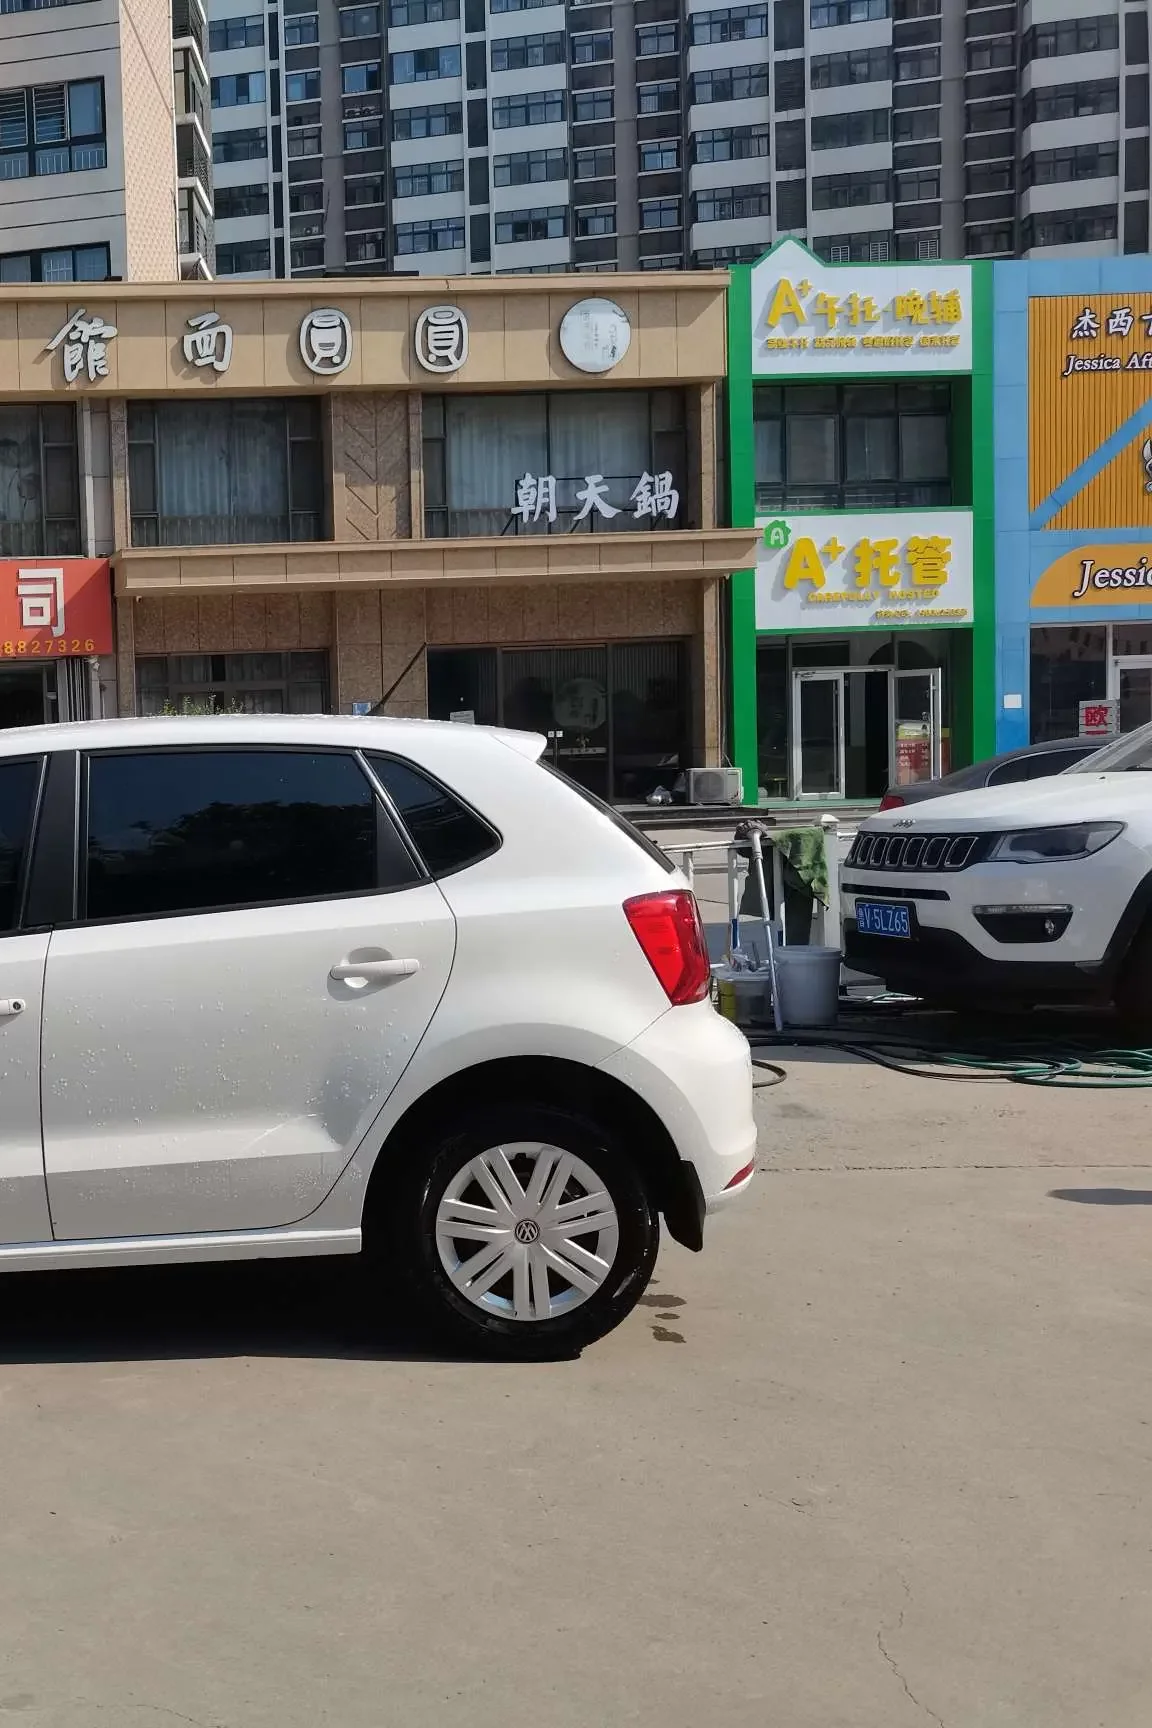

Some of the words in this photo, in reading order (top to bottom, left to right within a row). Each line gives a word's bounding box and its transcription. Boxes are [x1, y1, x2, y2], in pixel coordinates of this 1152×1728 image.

[1072, 308, 1152, 338] 杰西
[1062, 353, 1121, 376] Jessica
[510, 470, 680, 524] 朝天鍋
[784, 535, 952, 589] A+托管
